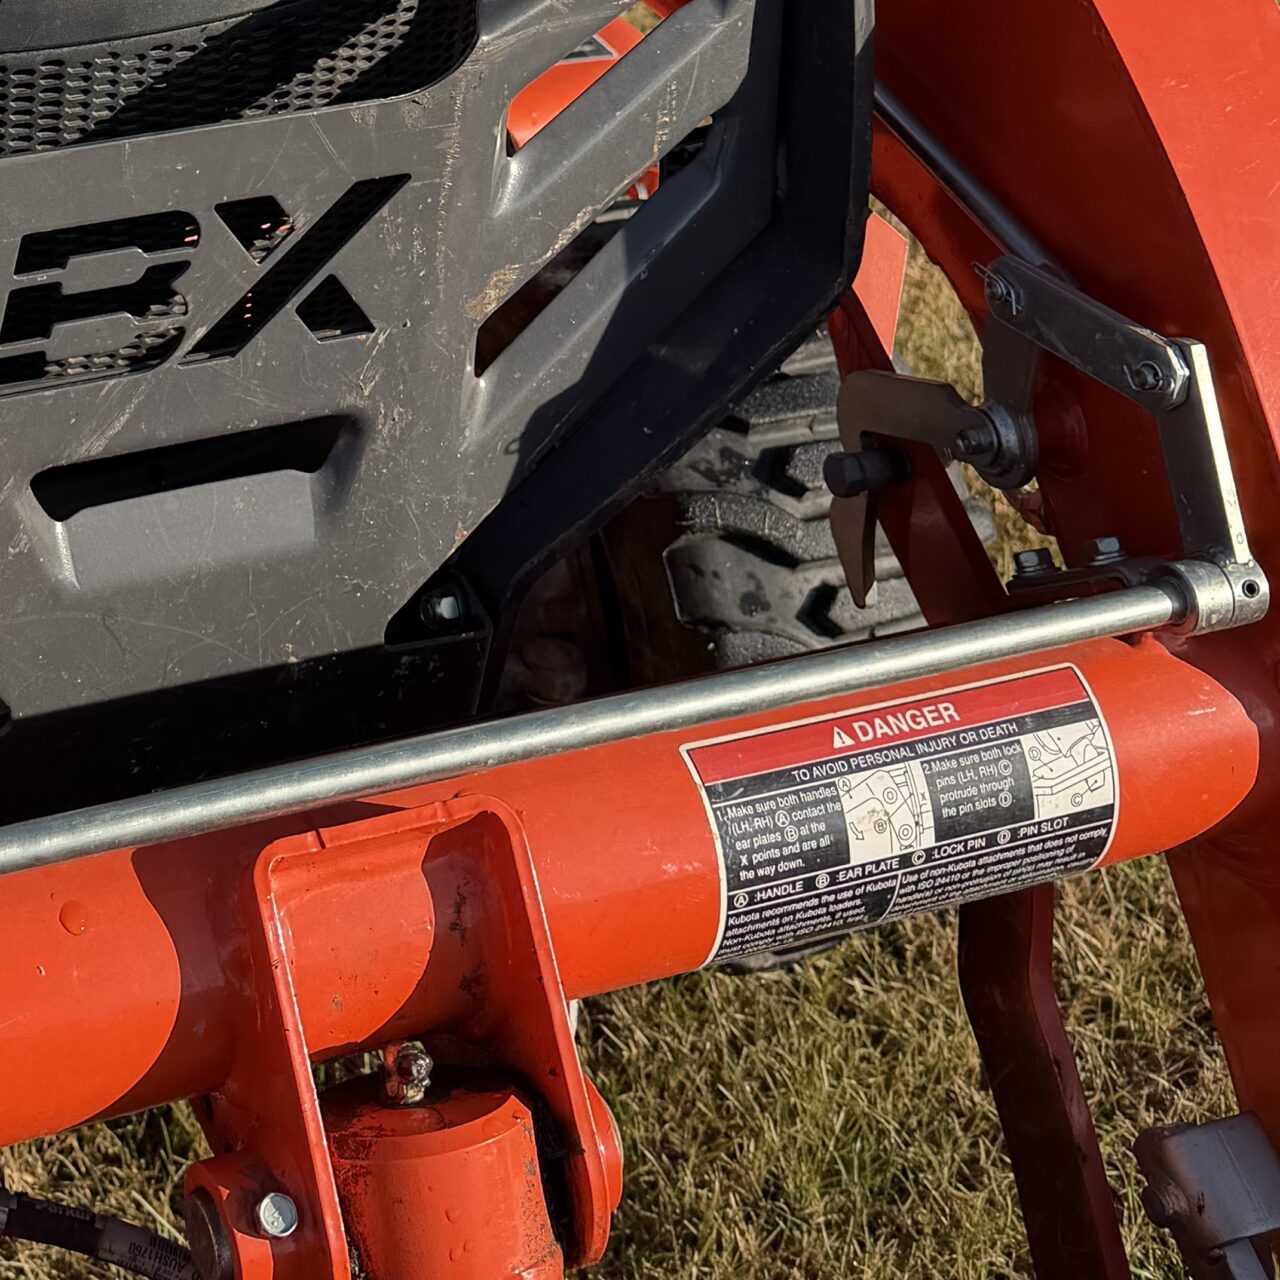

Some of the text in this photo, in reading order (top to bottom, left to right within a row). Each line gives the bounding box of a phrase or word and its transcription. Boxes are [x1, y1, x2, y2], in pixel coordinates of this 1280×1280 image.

[853, 699, 960, 744] DANGER
[792, 721, 1019, 783] TO AVOID PERSONAL INJURY OR DEATH
[959, 752, 980, 767] sure
[981, 746, 1002, 762] both
[1002, 741, 1023, 757] lock
[935, 773, 957, 790] pins
[957, 768, 978, 784] (LH,
[978, 762, 998, 778] RH)
[939, 775, 1016, 805] protrude through
[755, 800, 776, 813] sure
[777, 793, 800, 808] both
[800, 784, 838, 803] handles
[941, 805, 958, 818] the
[958, 801, 974, 816] pin
[974, 794, 997, 811] slots
[754, 815, 774, 831] RH)
[791, 803, 826, 821] contact
[826, 799, 842, 813] the
[735, 838, 752, 851] ear
[752, 829, 782, 849] plates
[799, 823, 811, 836] at
[811, 819, 826, 833] the
[751, 847, 781, 864] points
[781, 842, 801, 856] and
[801, 839, 818, 852] are
[818, 834, 831, 847] all
[864, 857, 902, 875] PLATE
[966, 837, 987, 851] PIN
[1040, 817, 1070, 832] SLOT
[739, 856, 805, 881] the way down.
[898, 883, 917, 895] with
[917, 878, 934, 891] ISO
[960, 870, 971, 880] or
[971, 866, 986, 877] the
[1021, 847, 1067, 866] positioning
[1064, 844, 1076, 854] of
[901, 873, 919, 885] Use
[919, 869, 930, 880] of
[928, 858, 977, 878] non-Kubota
[977, 846, 1027, 866] attachments
[1027, 842, 1044, 854] that
[1043, 837, 1064, 850] does
[1063, 833, 1079, 845] not
[727, 877, 898, 926] Kubota recommends the use of Kubota
[724, 916, 781, 937] attachments
[781, 915, 794, 924] on
[794, 906, 827, 921] Kubota
